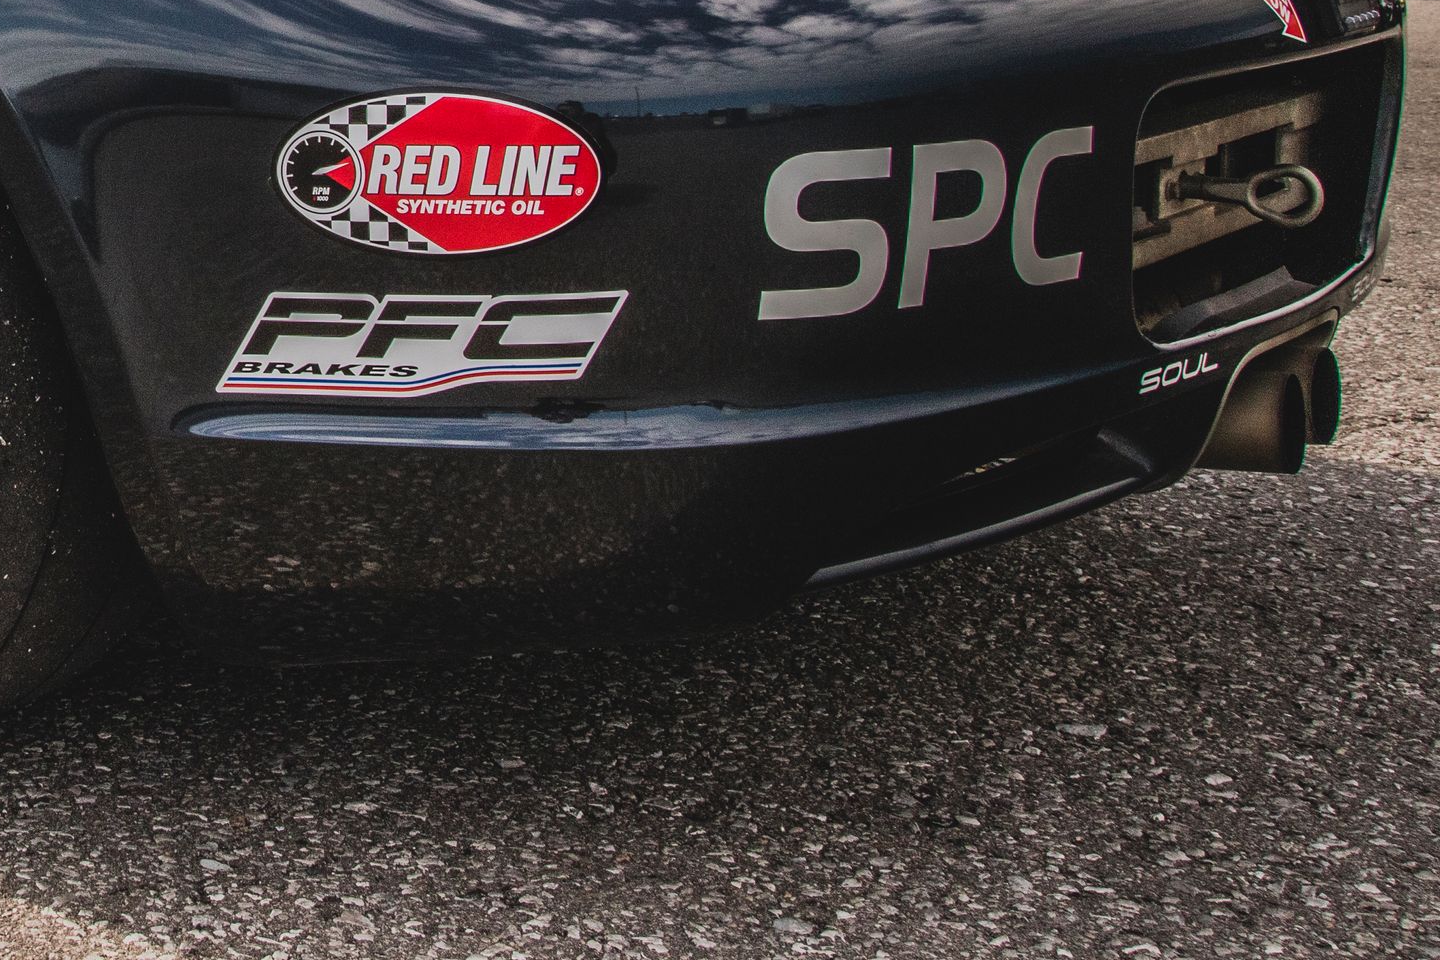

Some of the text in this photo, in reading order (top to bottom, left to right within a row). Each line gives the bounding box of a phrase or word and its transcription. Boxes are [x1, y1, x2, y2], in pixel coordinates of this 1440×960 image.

[312, 186, 331, 195] RPM
[366, 144, 461, 195] RED
[396, 198, 545, 216] SYNTHETIC OIL
[758, 125, 1094, 320] SPC
[241, 295, 623, 360] PFC
[231, 361, 419, 377] BRAKES
[1138, 351, 1219, 395] SOUL
